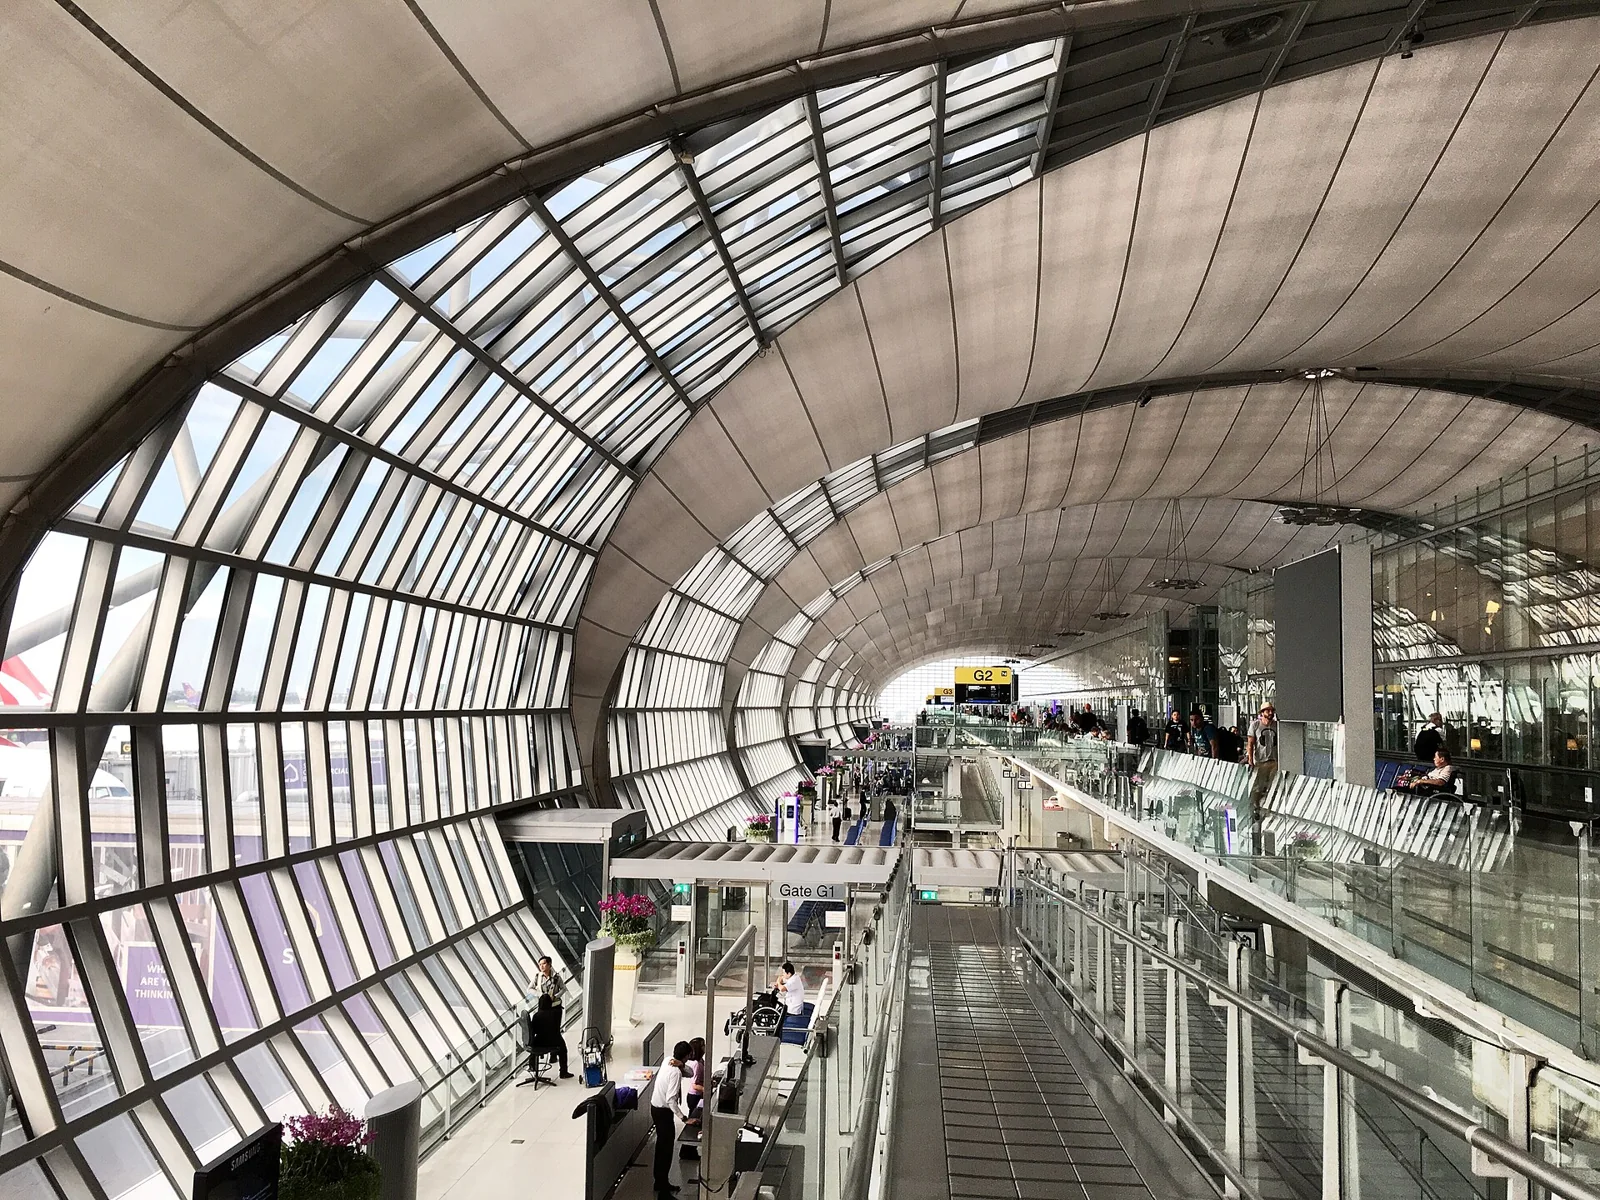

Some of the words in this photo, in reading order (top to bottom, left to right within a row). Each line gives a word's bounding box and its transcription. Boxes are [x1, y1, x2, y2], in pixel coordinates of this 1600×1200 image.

[974, 670, 993, 681] G2
[780, 884, 812, 897] Gate
[816, 884, 834, 898] G1
[140, 977, 160, 986] ARE
